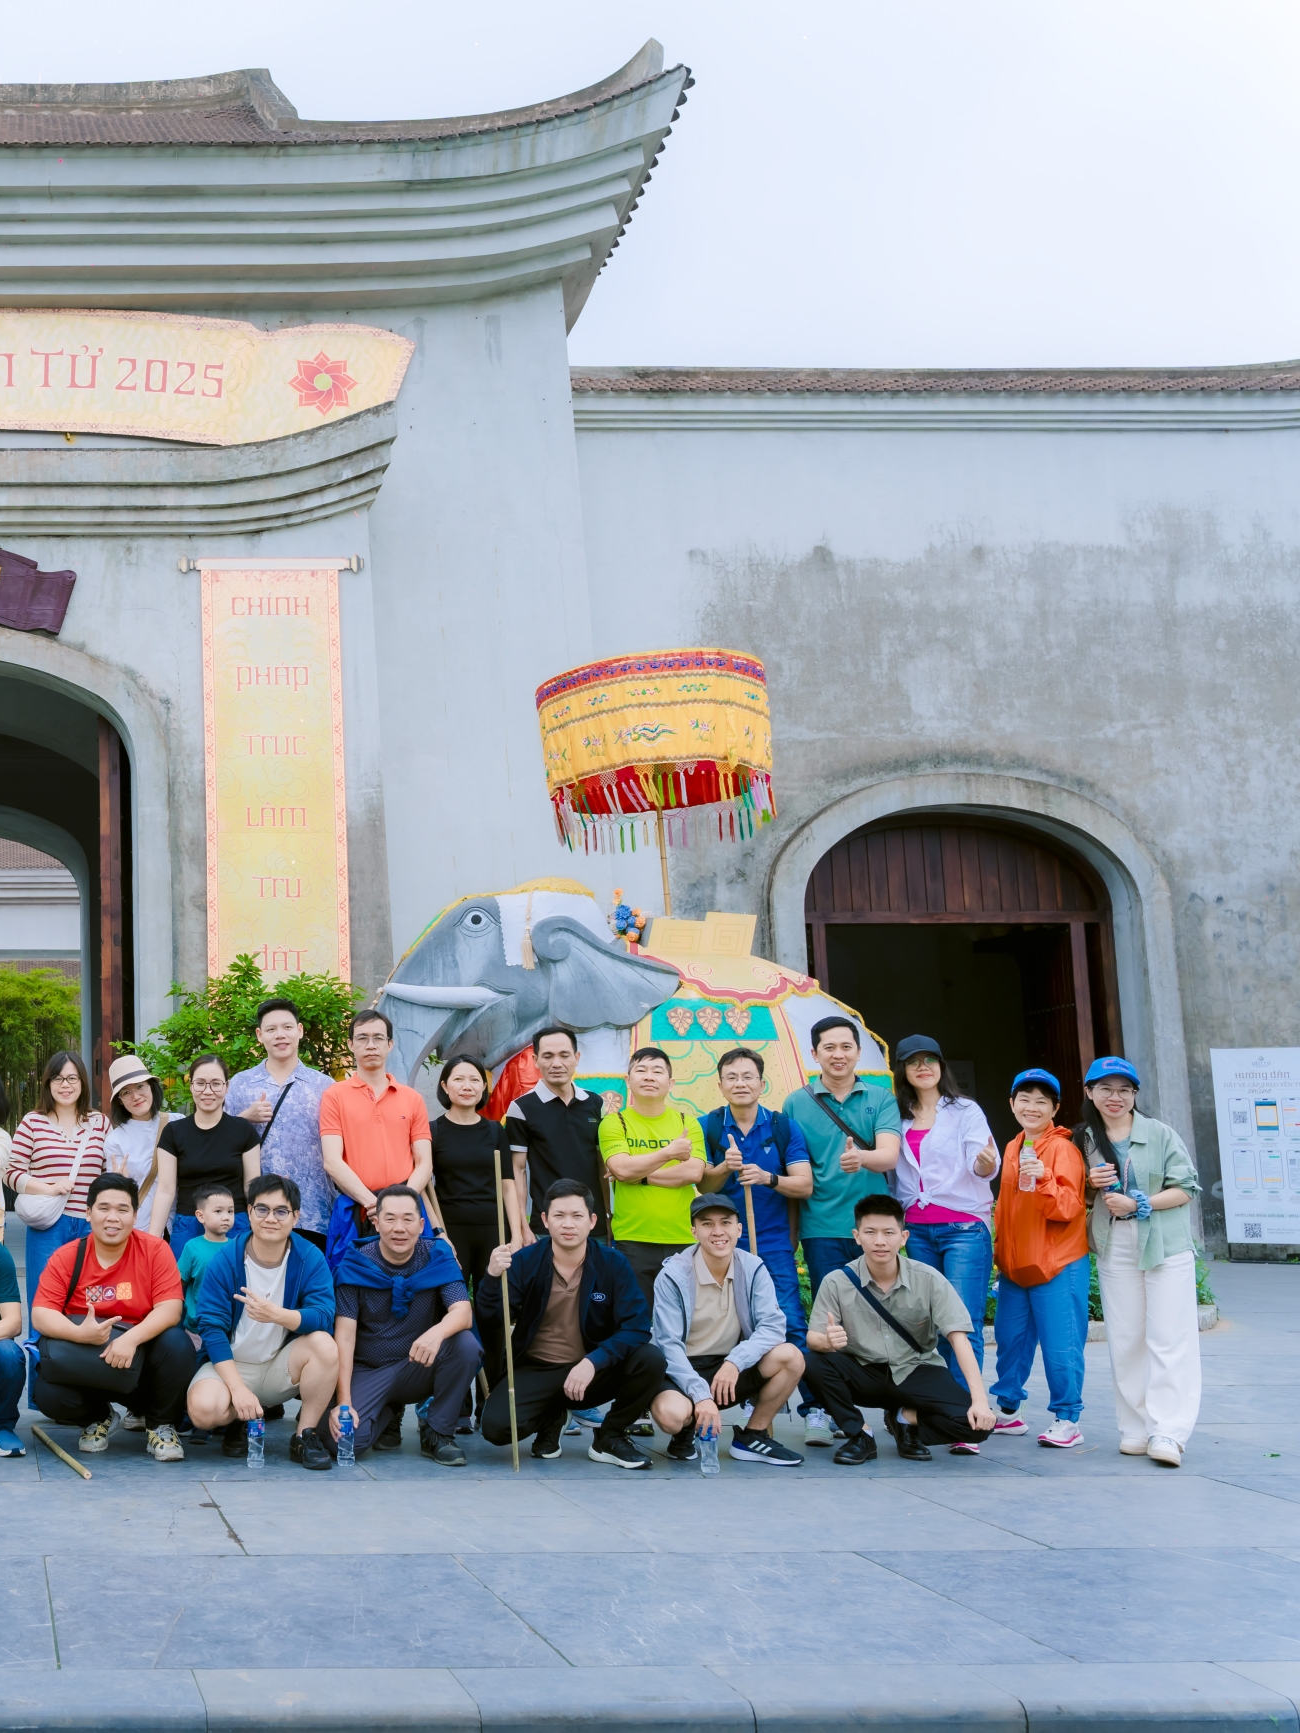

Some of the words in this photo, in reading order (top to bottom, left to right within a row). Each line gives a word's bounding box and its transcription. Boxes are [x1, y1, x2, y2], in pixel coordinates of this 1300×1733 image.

[30, 345, 104, 389] TỬ
[115, 357, 225, 399] 2025
[231, 592, 311, 616] CHÍNH
[236, 662, 309, 692] PHÁP
[241, 731, 307, 756] TRÚC
[245, 802, 308, 827] LÂM
[252, 875, 302, 903] TRỤ
[626, 1138, 673, 1149] DIADO
